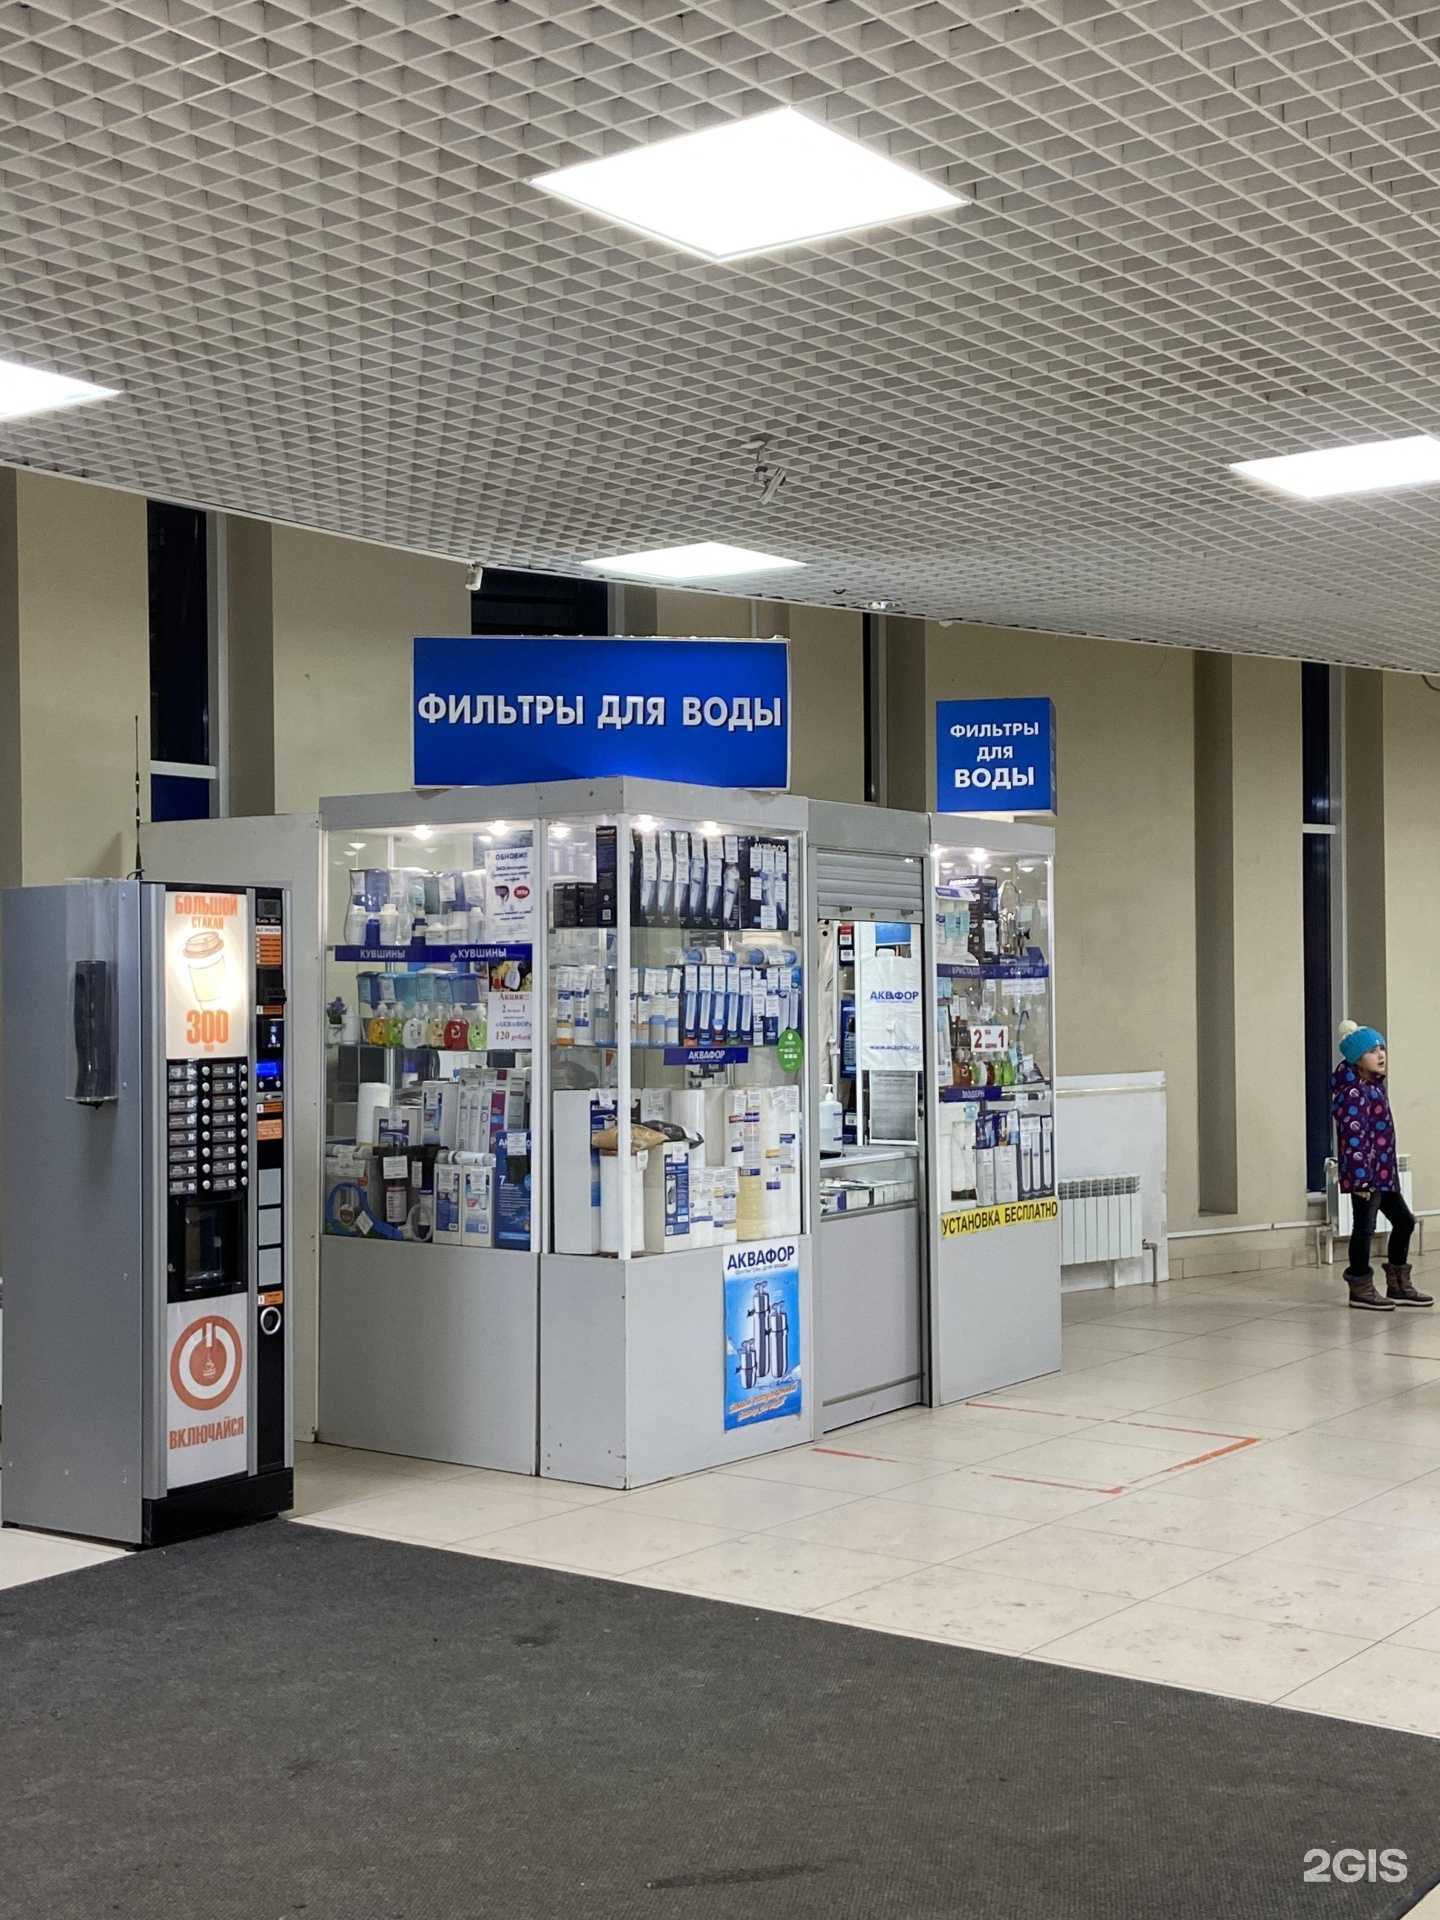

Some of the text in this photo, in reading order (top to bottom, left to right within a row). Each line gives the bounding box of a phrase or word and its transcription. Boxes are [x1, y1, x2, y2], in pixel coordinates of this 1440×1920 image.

[417, 693, 782, 732] ФИЛЬТРЫ ДЛЯ ВОДЫ
[950, 722, 1039, 738] ФИЛЬТРЫ
[976, 745, 1014, 762] ДЛЯ
[954, 766, 1035, 791] ВОДЫ
[175, 894, 238, 916] БОЛЬШОЙ
[191, 916, 225, 930] СТАКАН
[360, 948, 406, 960] КУВШИНЫ
[458, 947, 507, 960] КУВШИНЫ
[870, 990, 920, 1000] АКВАФОР
[186, 1008, 230, 1045] 300
[973, 1029, 983, 1049] 2
[998, 1029, 1004, 1049] 1
[687, 1049, 726, 1060] АКВАФОР
[942, 1201, 1058, 1237] УСТАНОВКА БЕСПЛАТНО
[727, 1245, 796, 1271] АКВАФОР
[168, 1416, 244, 1451] ВКЛЮЧАЙСЯ
